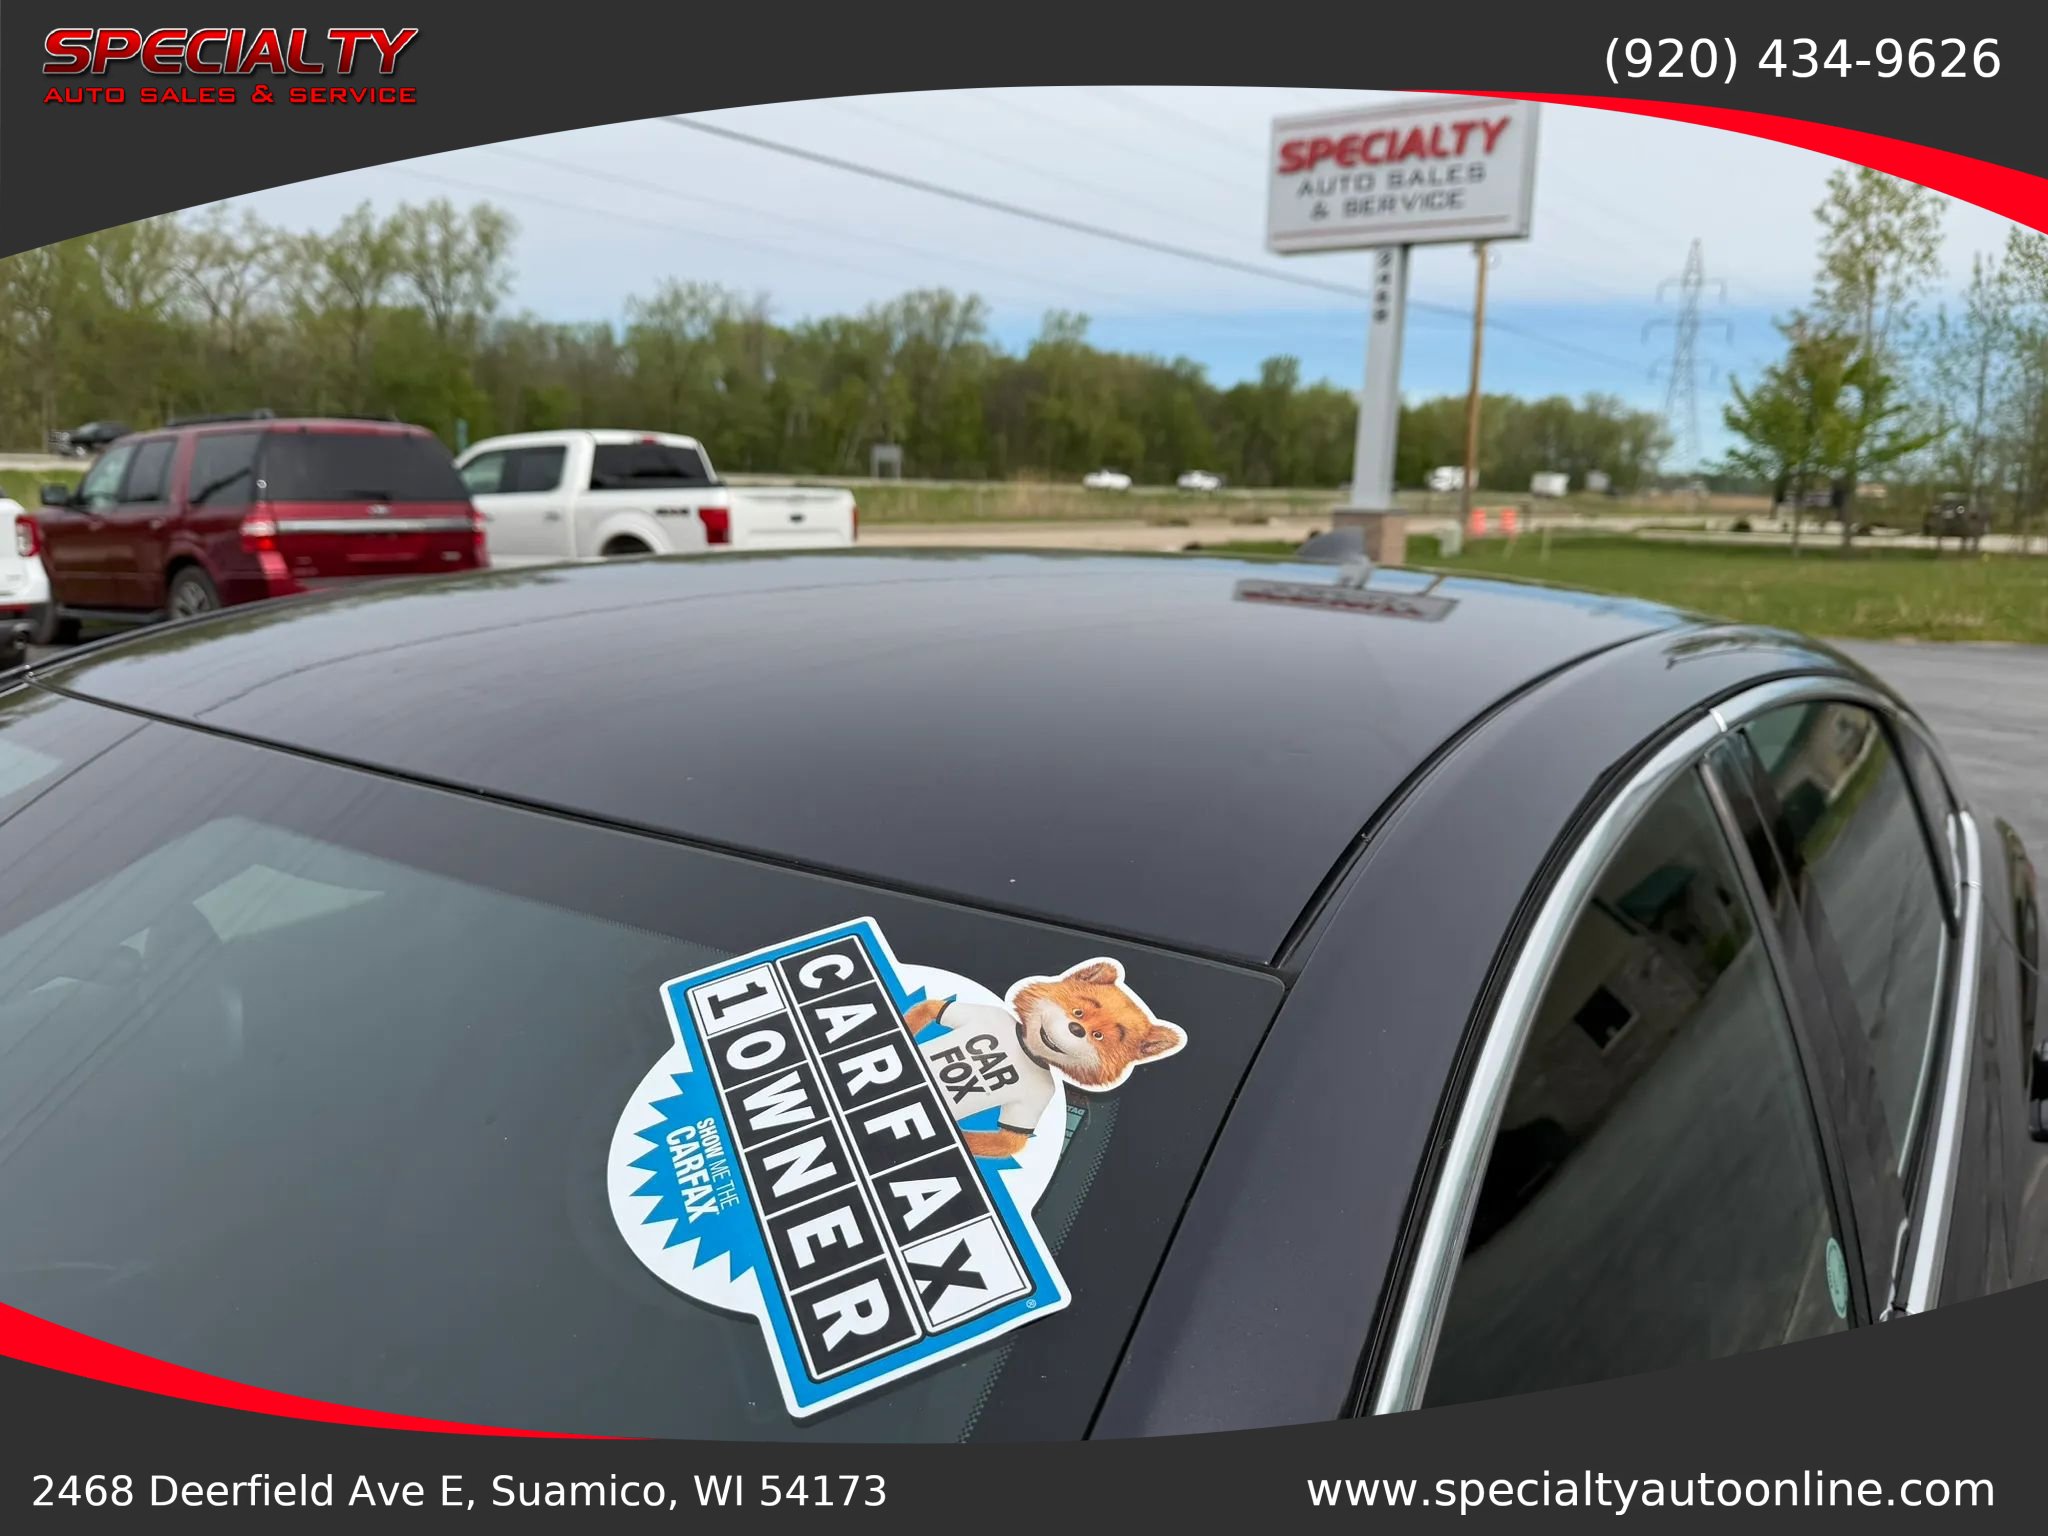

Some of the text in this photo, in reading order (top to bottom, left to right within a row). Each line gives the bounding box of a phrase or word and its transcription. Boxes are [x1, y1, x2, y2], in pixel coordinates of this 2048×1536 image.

[1276, 115, 1512, 175] SPECIALTY
[1297, 161, 1486, 198] AUTO SALES
[1310, 187, 1466, 221] & SERVICE
[930, 1046, 986, 1104] FOX
[965, 1034, 1019, 1091] CAR
[696, 1117, 740, 1210] SHOW ME THE
[799, 953, 989, 1314] CARFAX
[666, 1125, 719, 1224] CARFAX
[707, 981, 890, 1352] 1 OWNER
